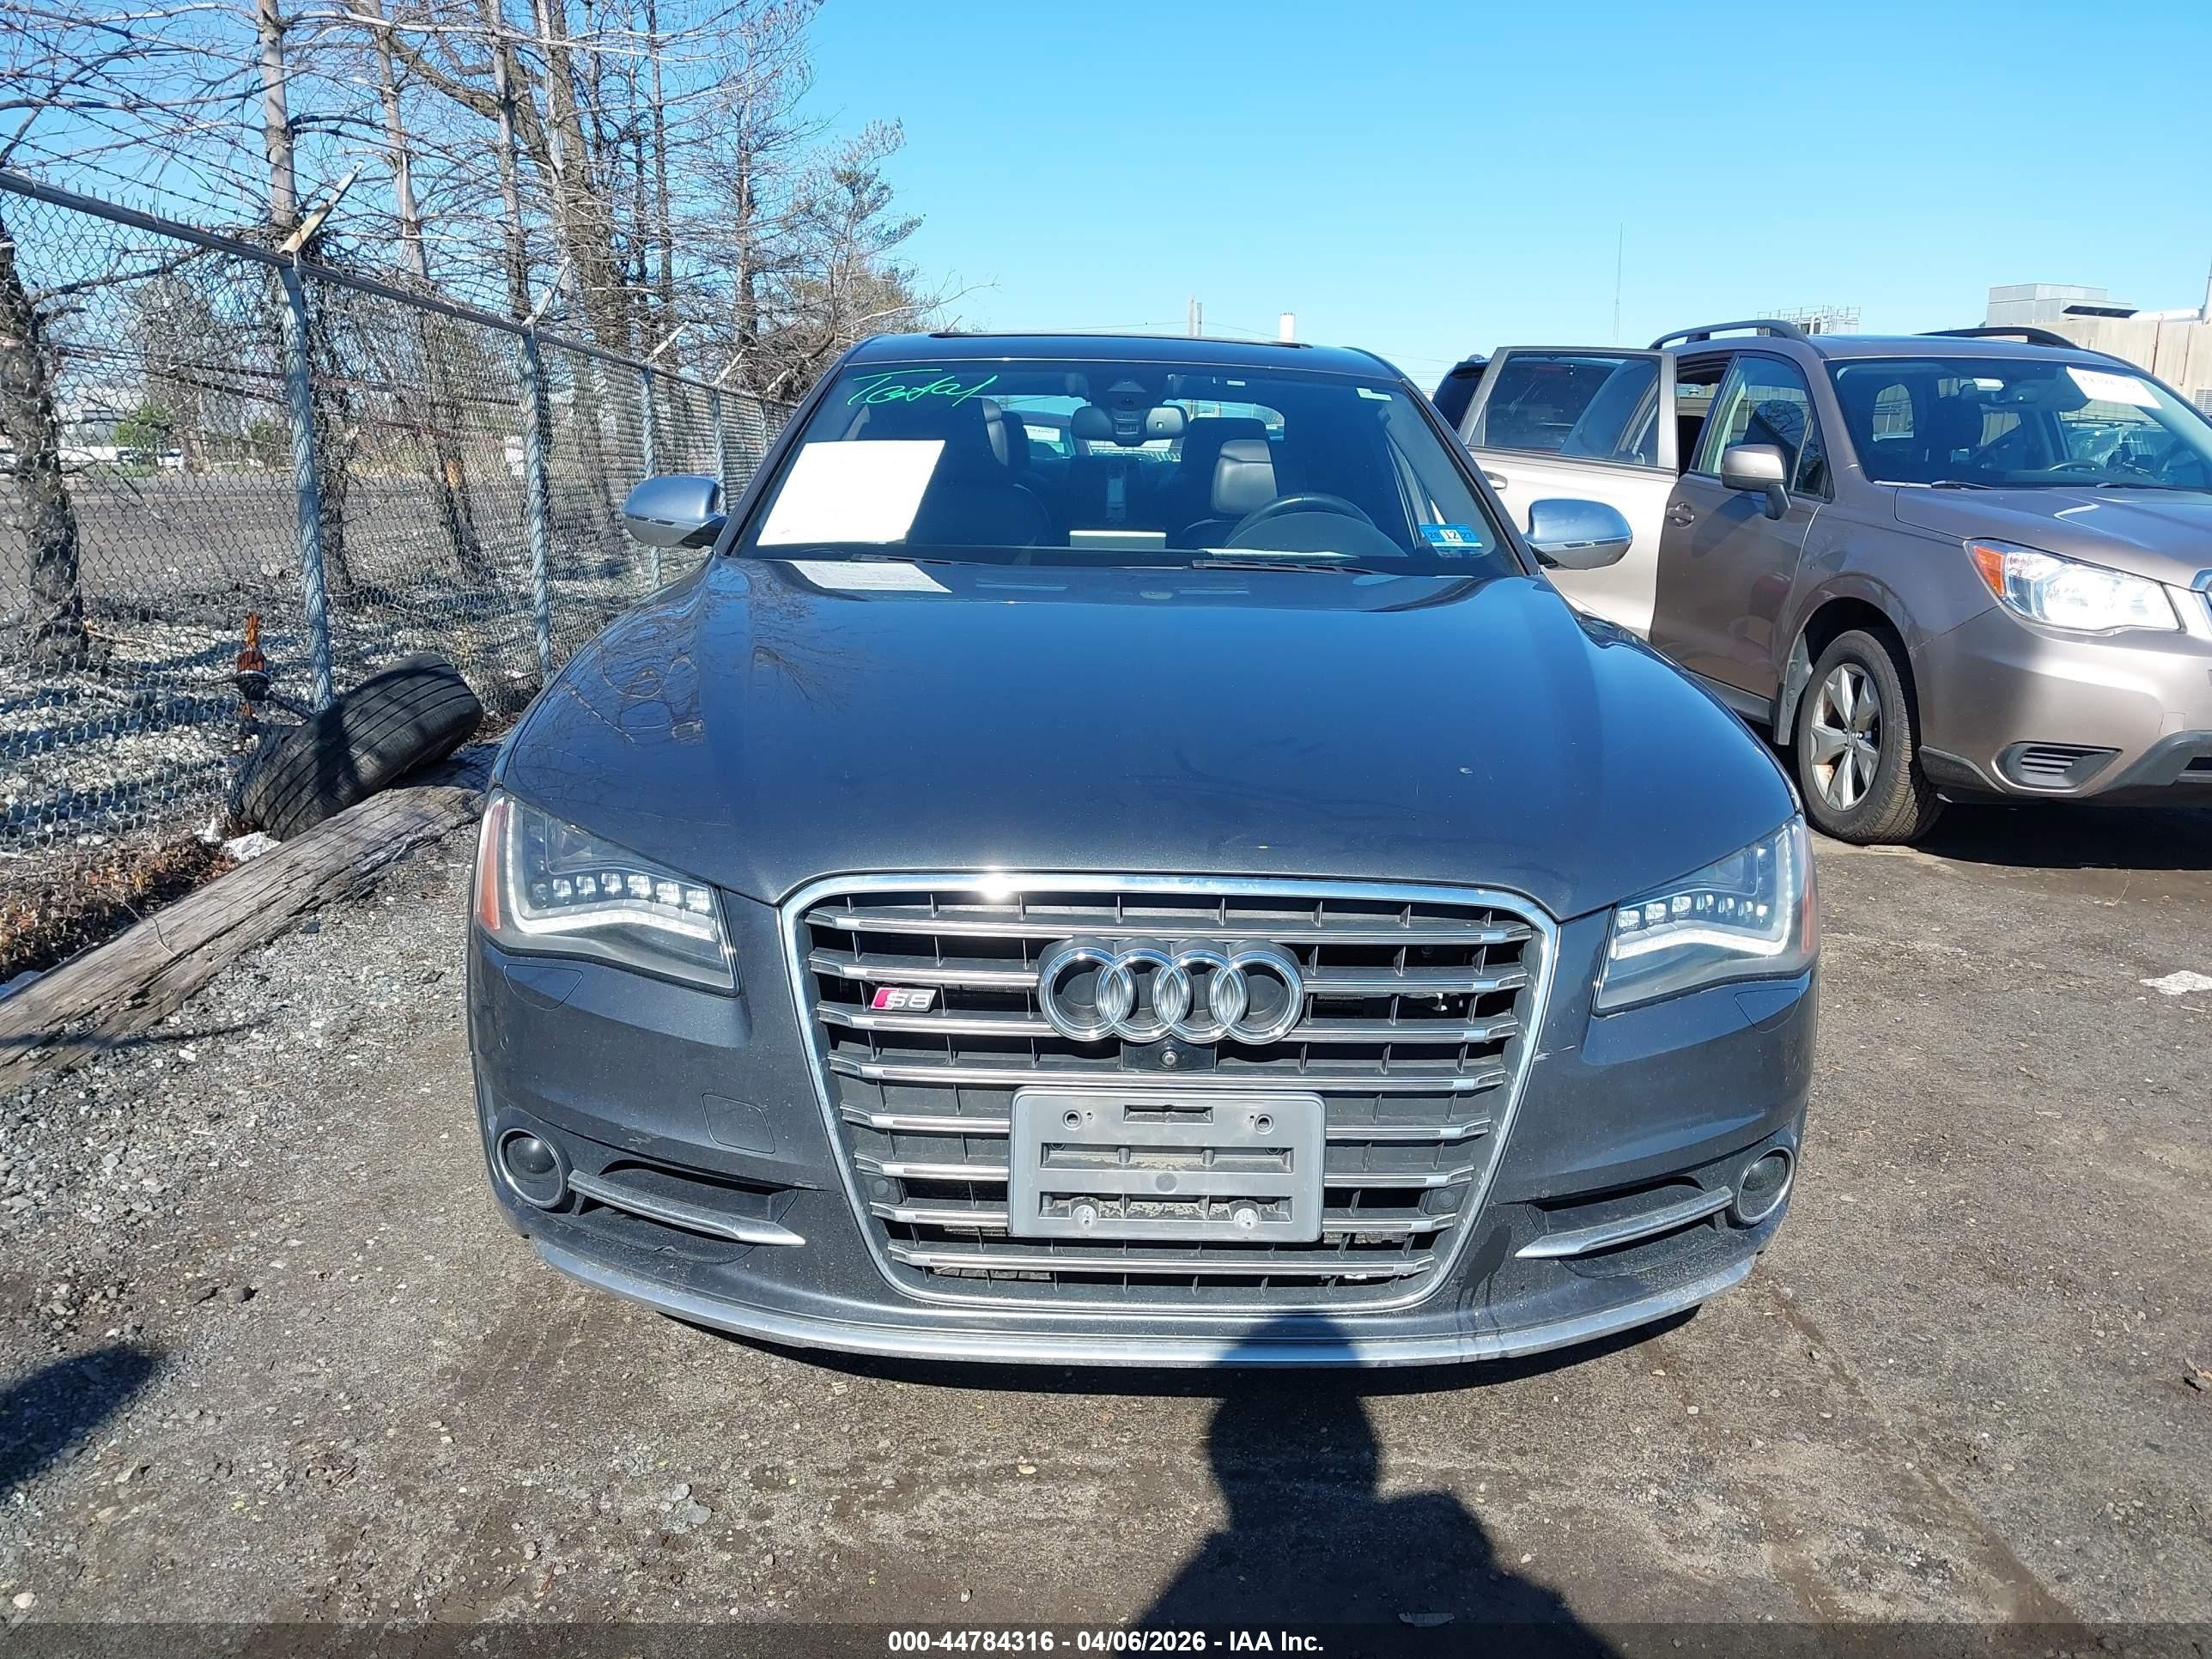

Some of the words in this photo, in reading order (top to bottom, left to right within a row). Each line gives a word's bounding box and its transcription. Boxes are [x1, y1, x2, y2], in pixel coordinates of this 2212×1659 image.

[847, 368, 998, 408] Total
[1443, 530, 1460, 540] 12
[884, 991, 931, 1009] S8
